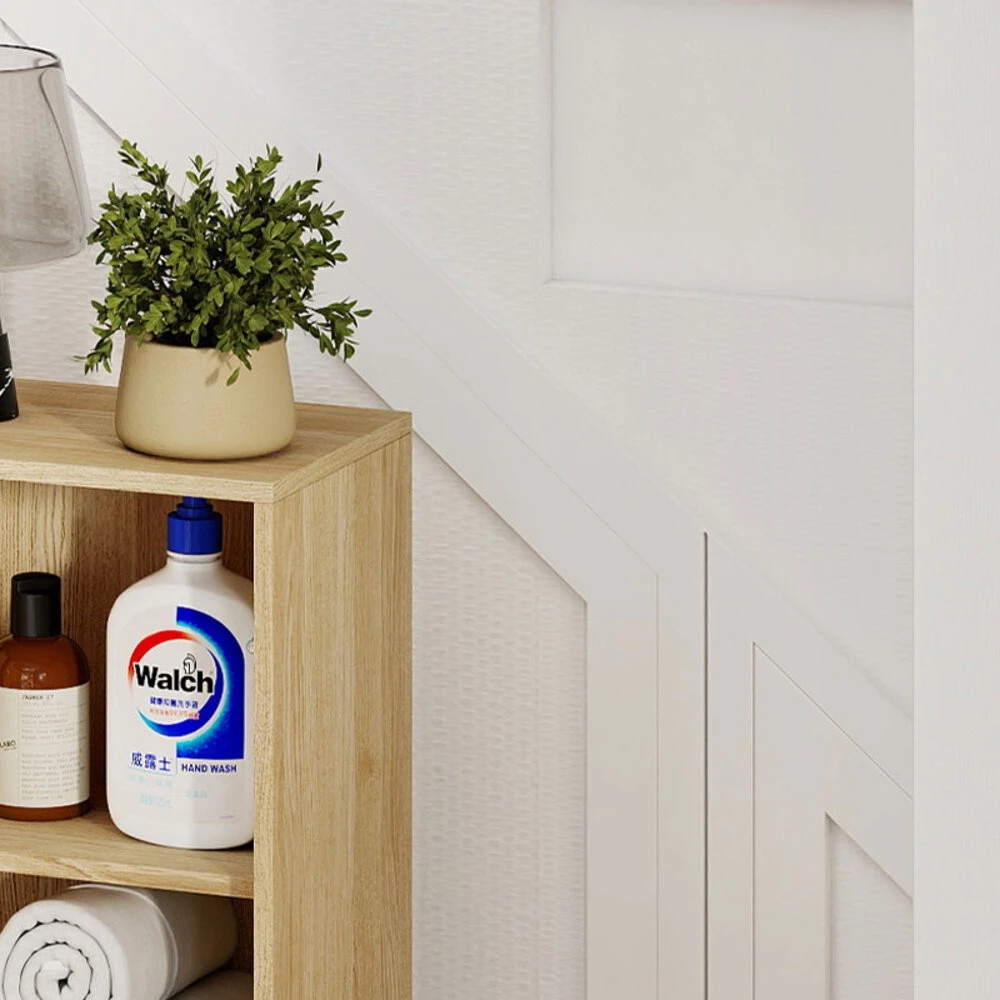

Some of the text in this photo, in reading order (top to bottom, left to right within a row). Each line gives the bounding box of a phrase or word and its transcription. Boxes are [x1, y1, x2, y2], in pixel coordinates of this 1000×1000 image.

[135, 664, 213, 693] Walch
[131, 752, 171, 772] 威露士
[181, 764, 237, 773] HAND WASH
